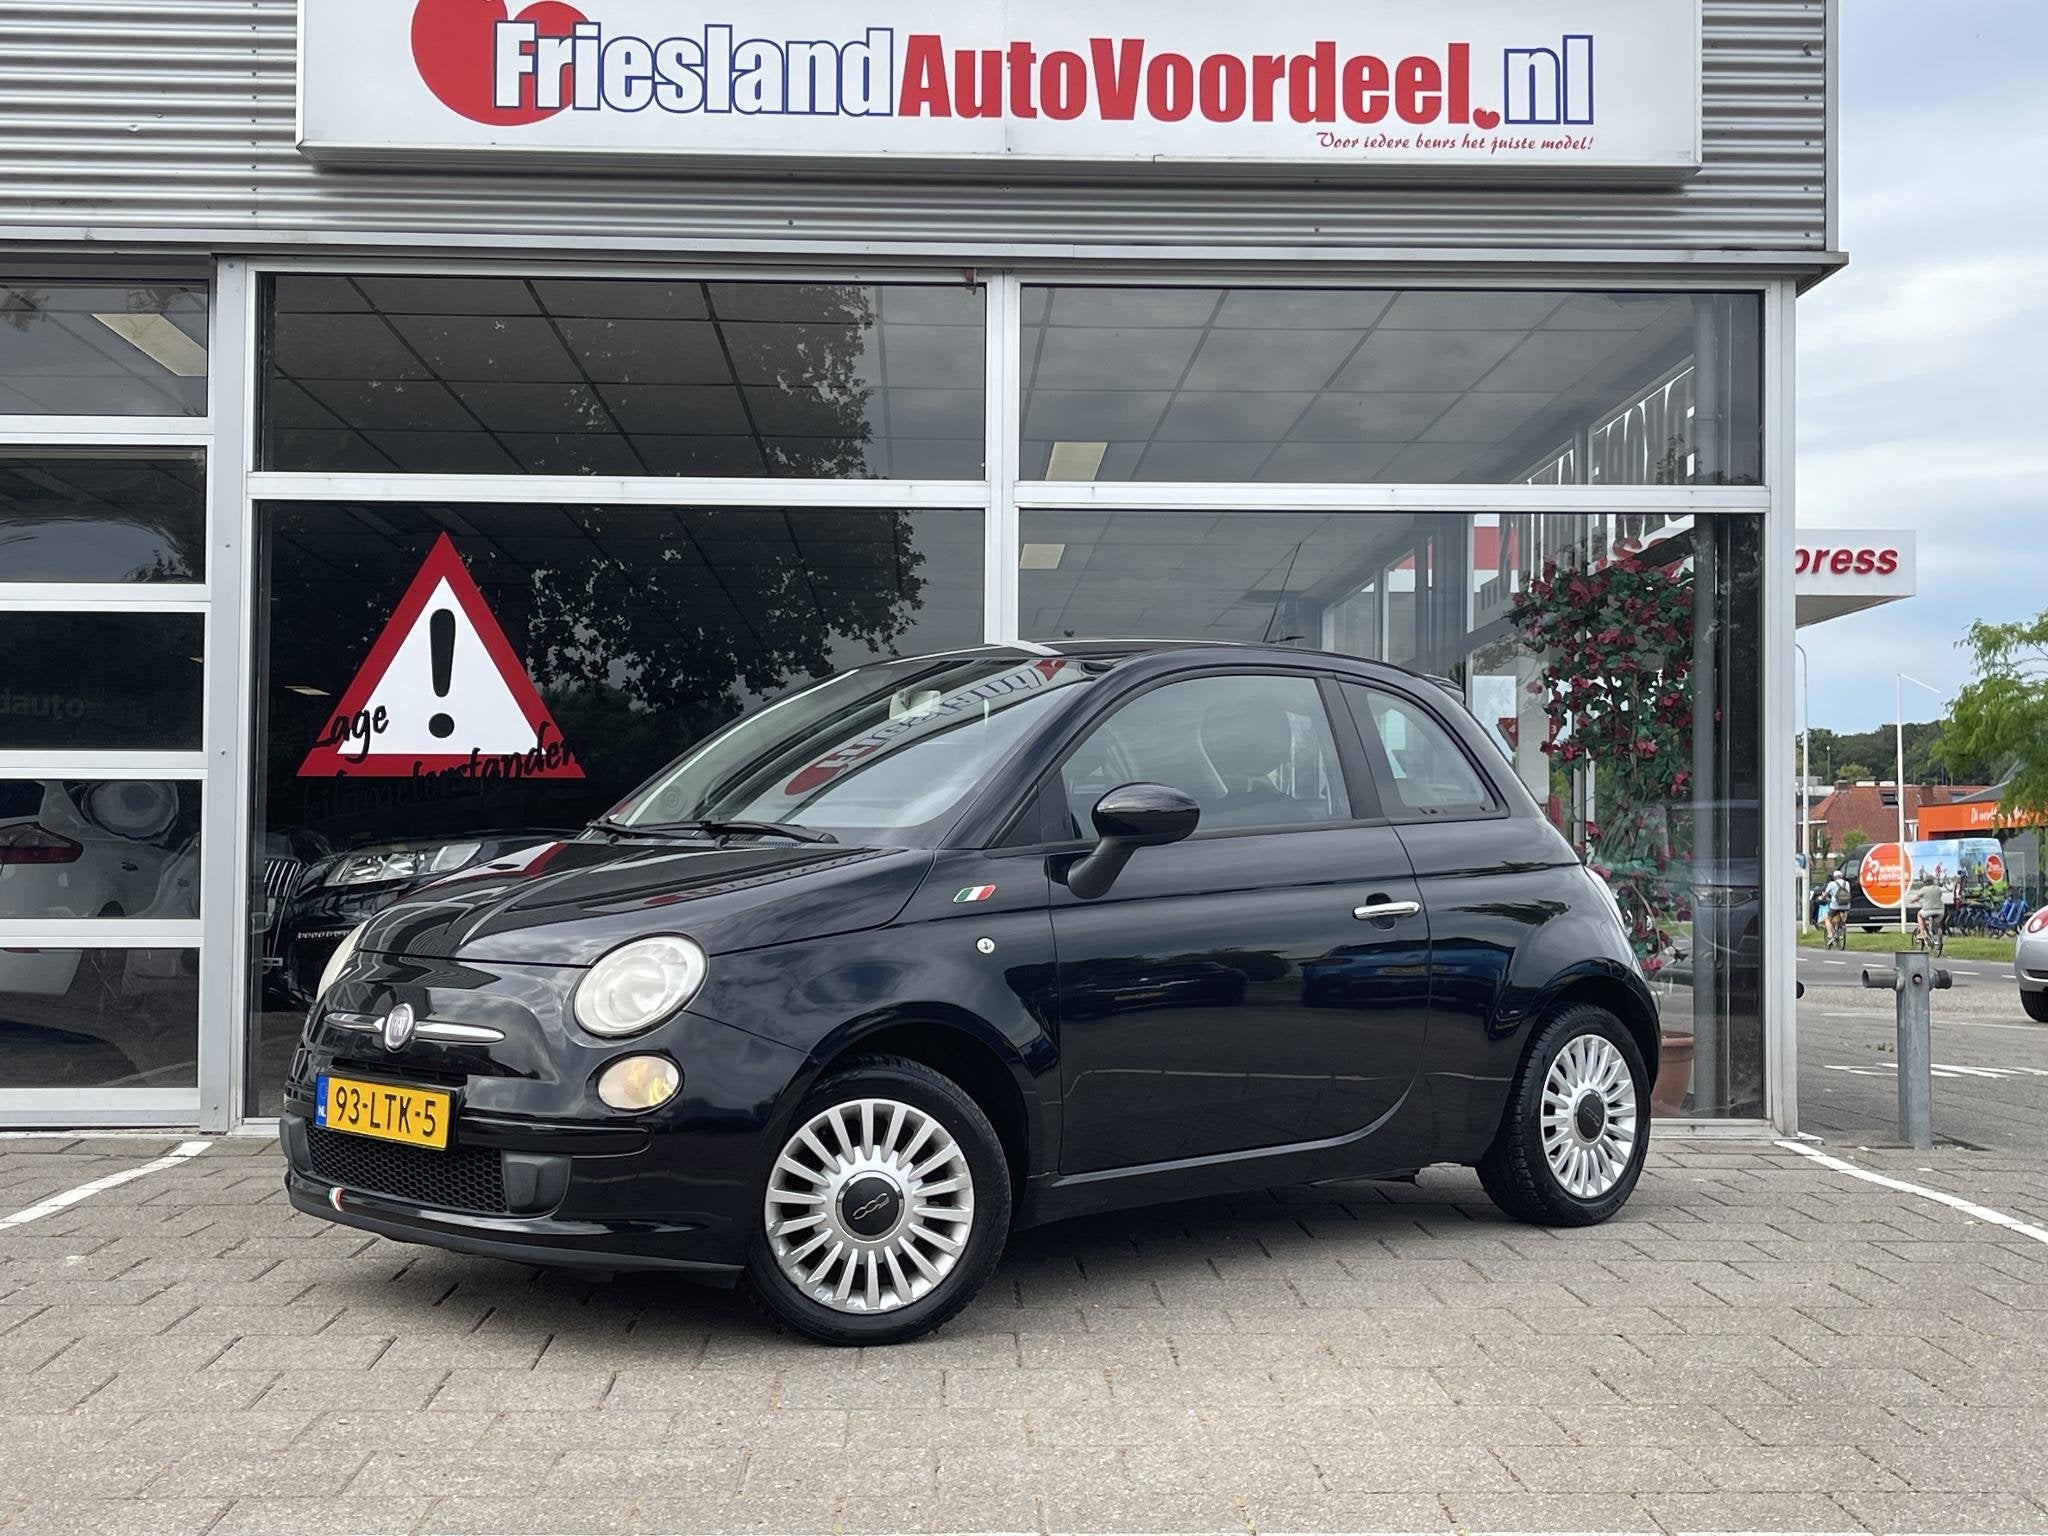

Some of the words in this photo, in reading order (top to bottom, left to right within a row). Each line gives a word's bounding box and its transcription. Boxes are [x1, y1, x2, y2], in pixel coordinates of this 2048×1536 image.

[493, 19, 1594, 130] FrieslandAutoVoordeel.nl
[1316, 132, 1359, 148] Voor
[1364, 135, 1410, 149] iedere
[1416, 135, 1456, 149] beurs
[1462, 134, 1486, 149] het
[1490, 137, 1536, 154] juiste
[1541, 135, 1594, 150] model!
[317, 1105, 327, 1117] NL
[335, 1086, 437, 1136] 93-LTK-5
